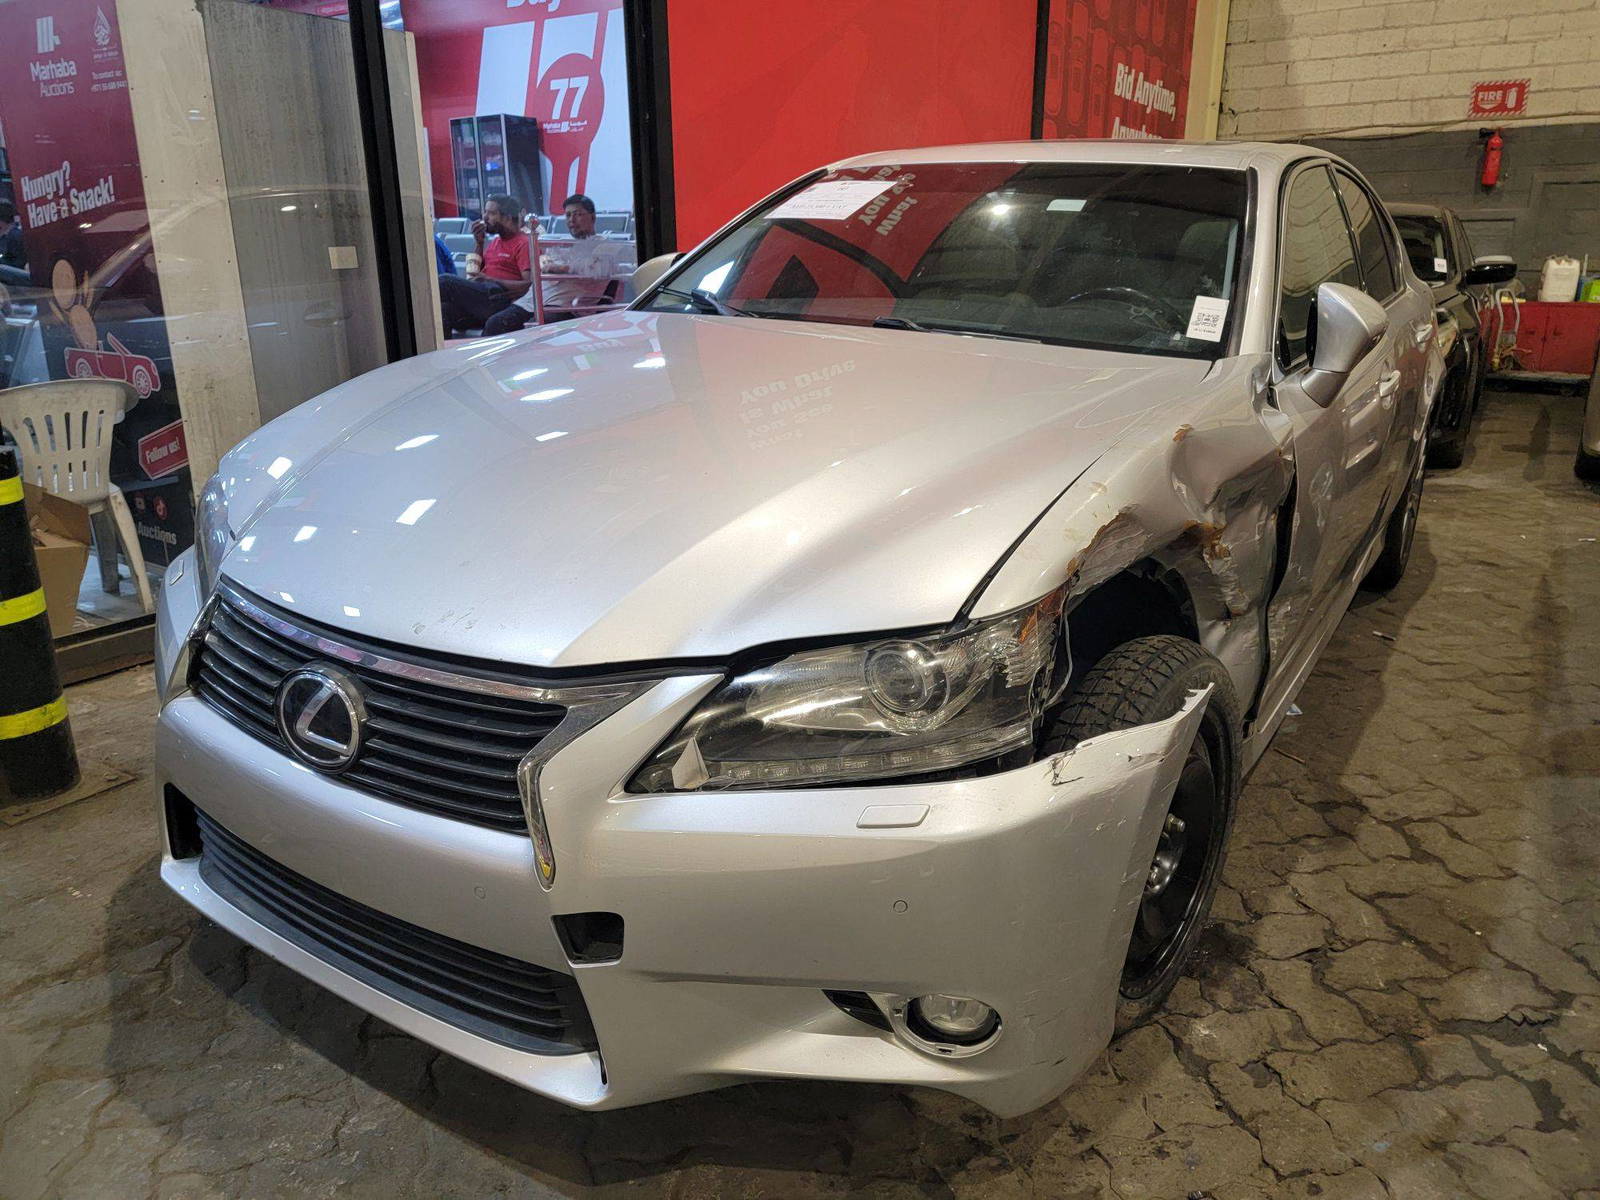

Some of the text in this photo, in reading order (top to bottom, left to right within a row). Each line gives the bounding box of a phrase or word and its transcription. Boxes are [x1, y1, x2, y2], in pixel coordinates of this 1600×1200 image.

[30, 57, 77, 82] Marhaba
[40, 81, 75, 98] Auctions
[550, 75, 589, 120] 77
[1114, 63, 1176, 122] Bid Anytime,
[1478, 90, 1503, 102] FIRE
[20, 160, 71, 203] Hungry?
[27, 174, 115, 229] Have a Snack!
[145, 445, 169, 464] Follow
